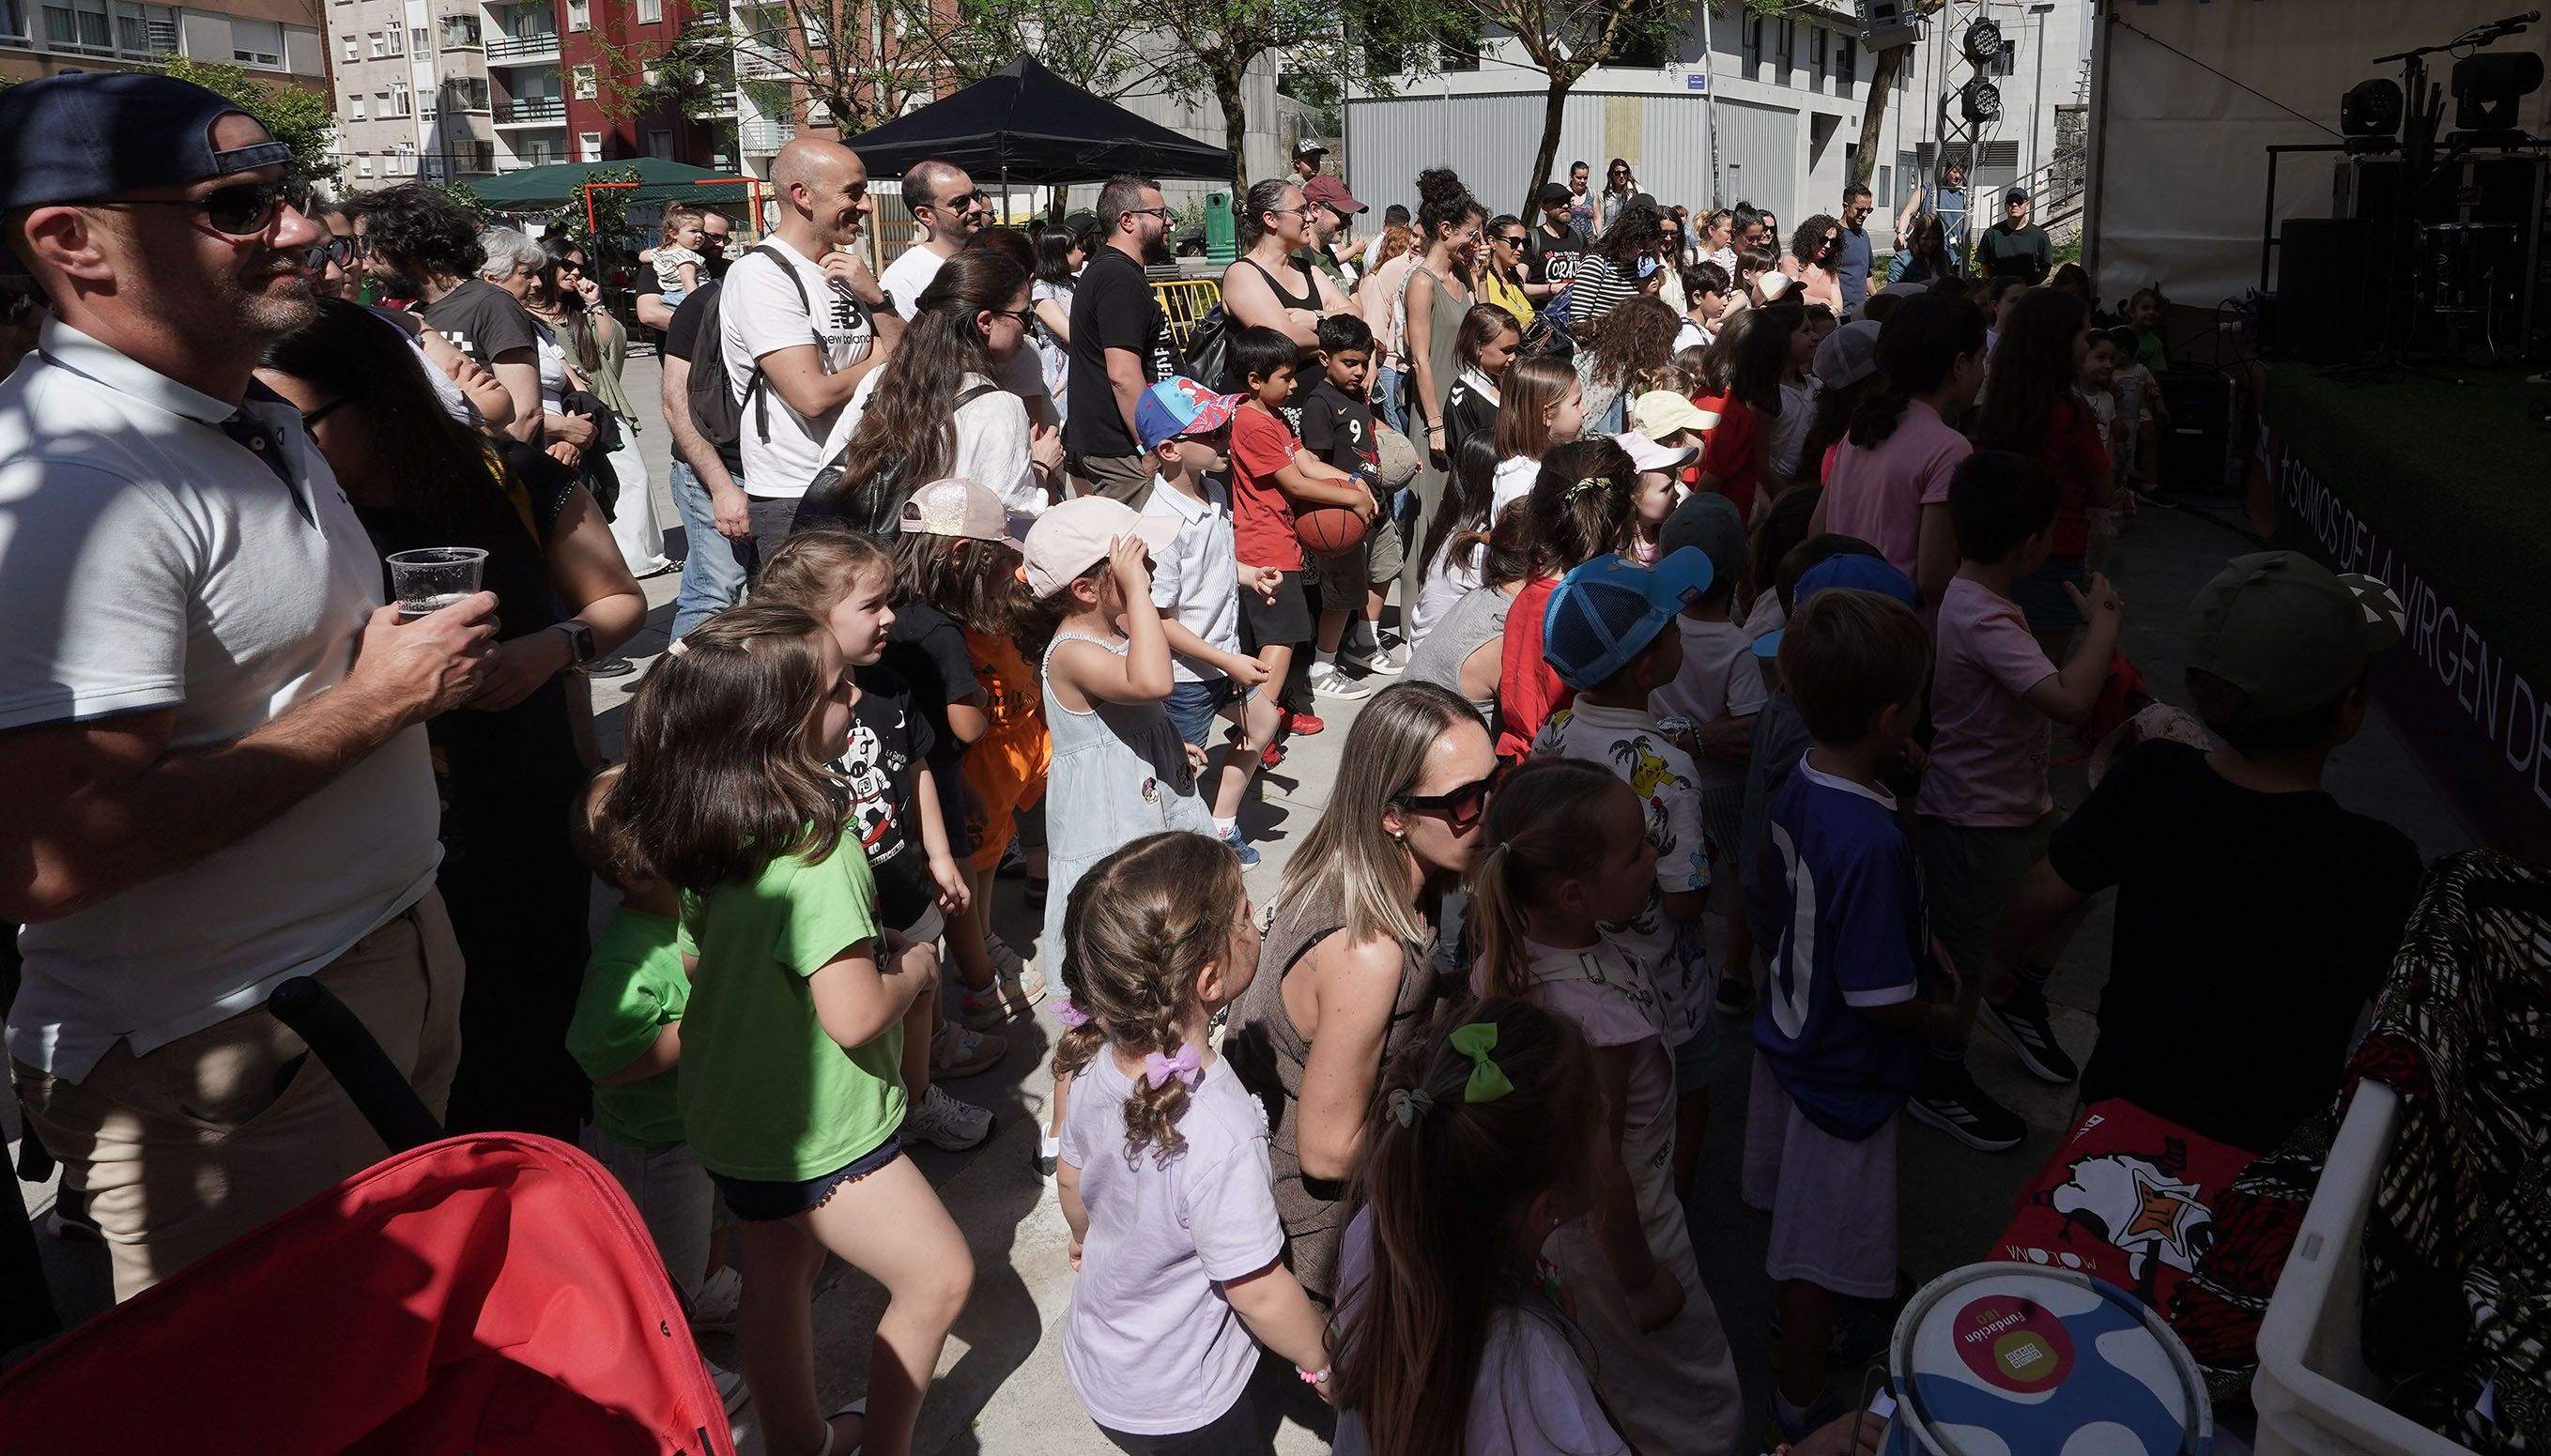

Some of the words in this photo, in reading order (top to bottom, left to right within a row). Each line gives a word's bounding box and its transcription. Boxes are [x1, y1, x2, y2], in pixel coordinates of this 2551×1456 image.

[1349, 419, 1362, 444] 9
[2402, 562, 2504, 742] VIRGEN
[1964, 1310, 2027, 1343] Fundación
